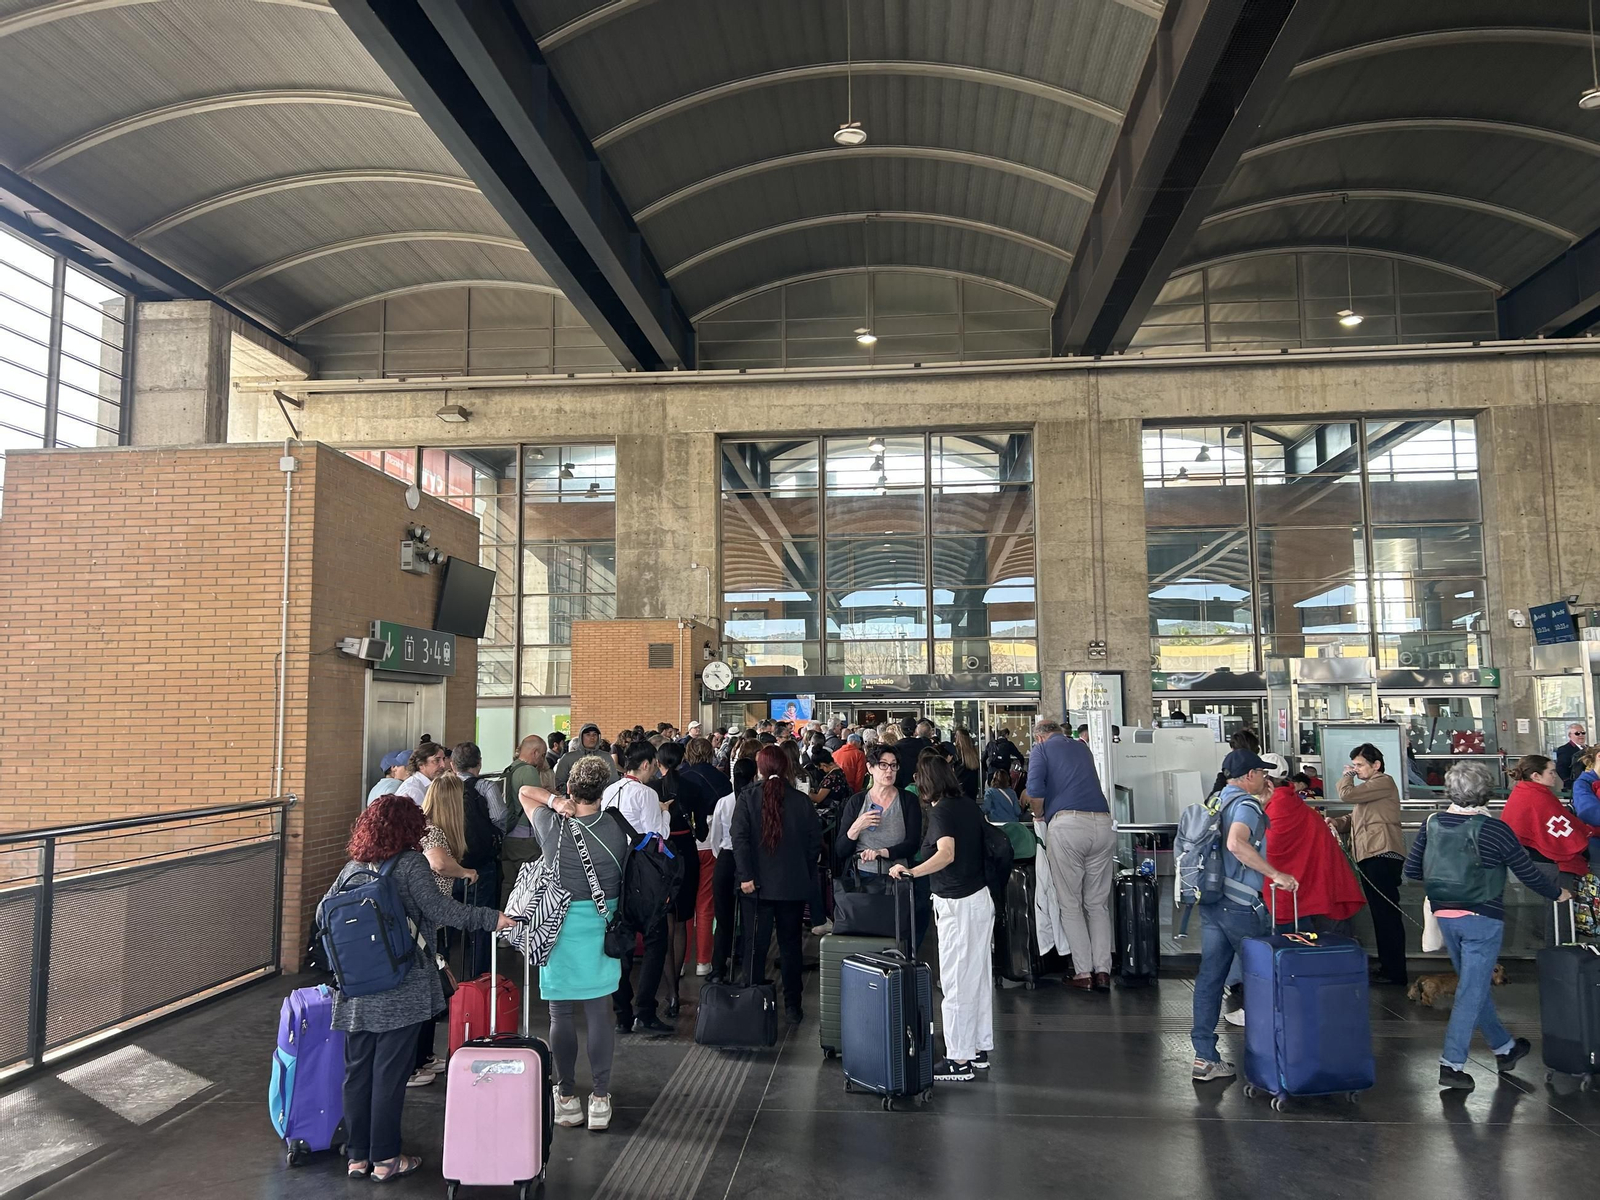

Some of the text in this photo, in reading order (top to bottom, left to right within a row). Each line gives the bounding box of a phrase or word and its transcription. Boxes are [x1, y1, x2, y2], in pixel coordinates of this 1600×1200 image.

[1006, 676, 1021, 686] P1
[1461, 671, 1477, 682] P1
[738, 680, 751, 690] P2
[577, 840, 590, 861] LOLA
